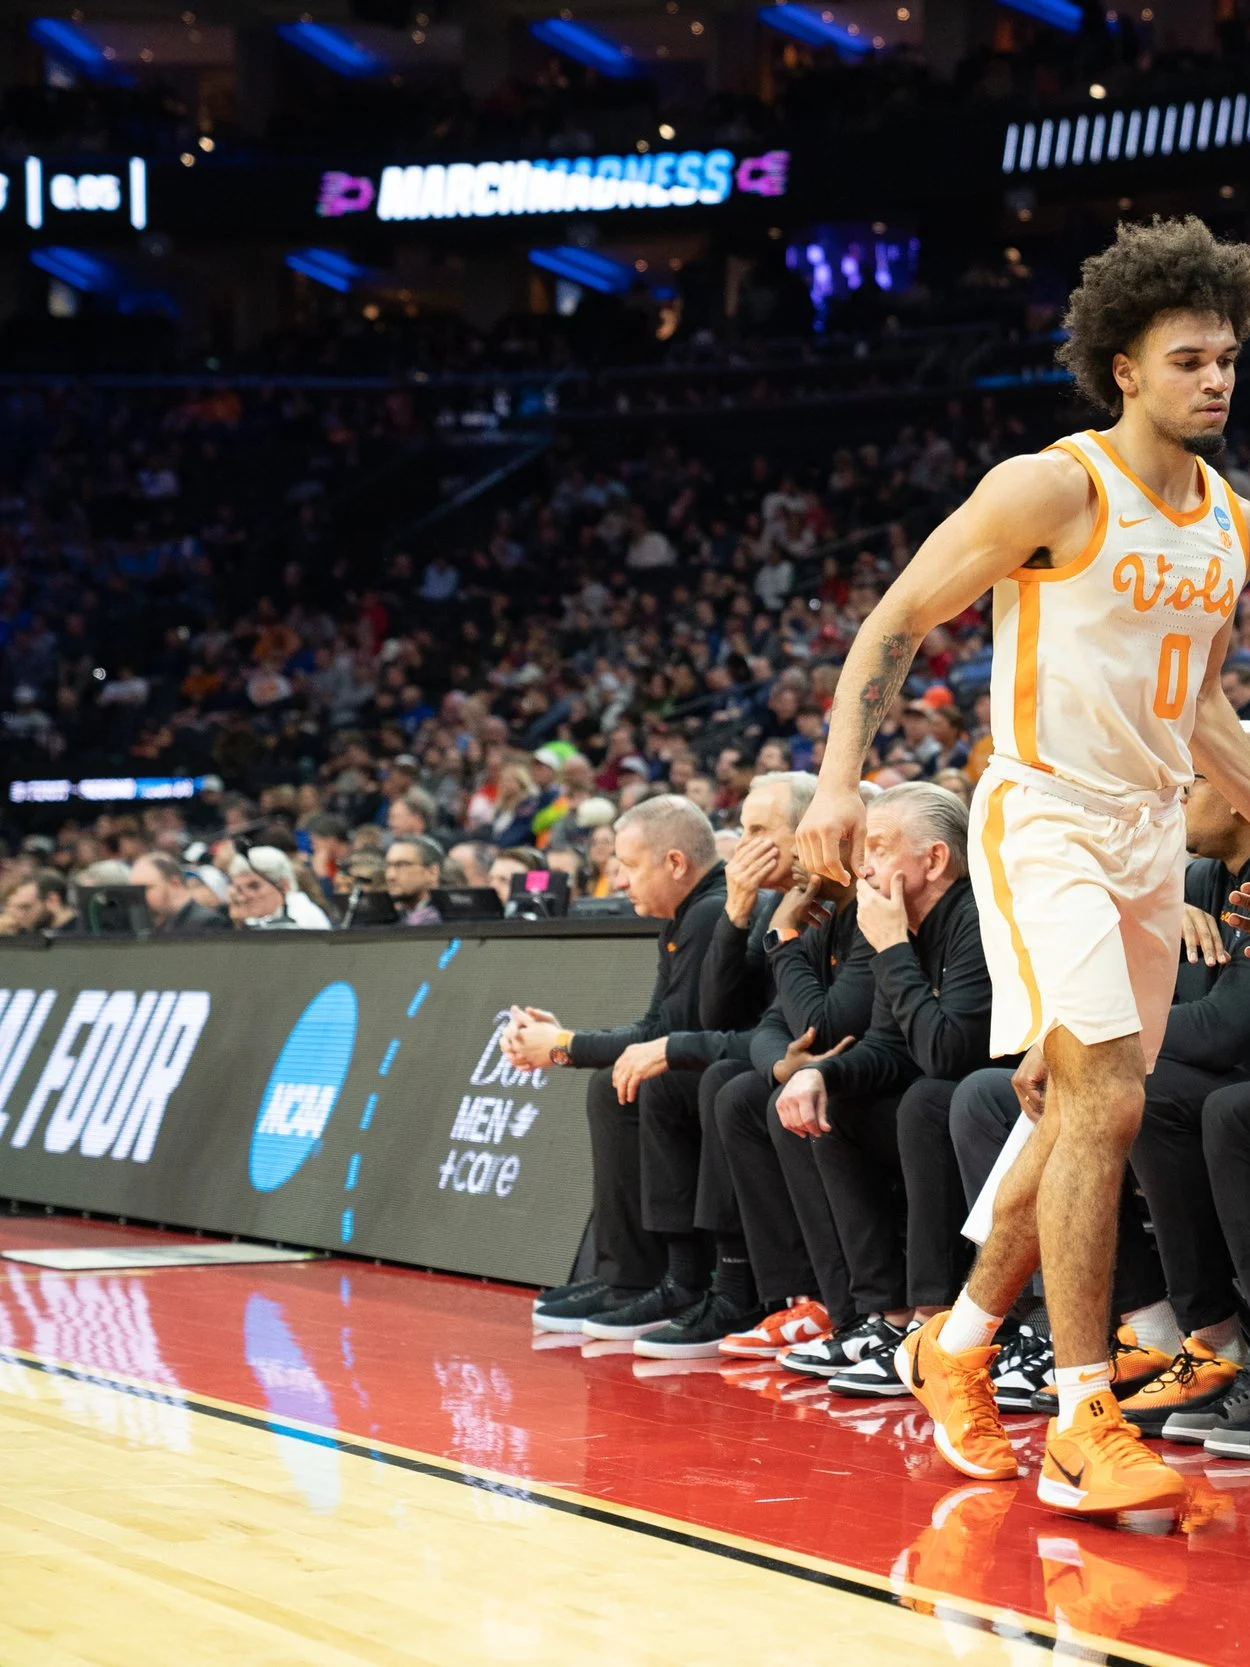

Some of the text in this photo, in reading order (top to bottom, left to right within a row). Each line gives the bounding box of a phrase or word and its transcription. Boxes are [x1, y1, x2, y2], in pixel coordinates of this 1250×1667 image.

[1112, 553, 1236, 618] Vols
[1153, 633, 1192, 720] 0
[11, 990, 210, 1164] FOUR
[256, 1082, 337, 1139] NCAA
[450, 1095, 514, 1145] MEN
